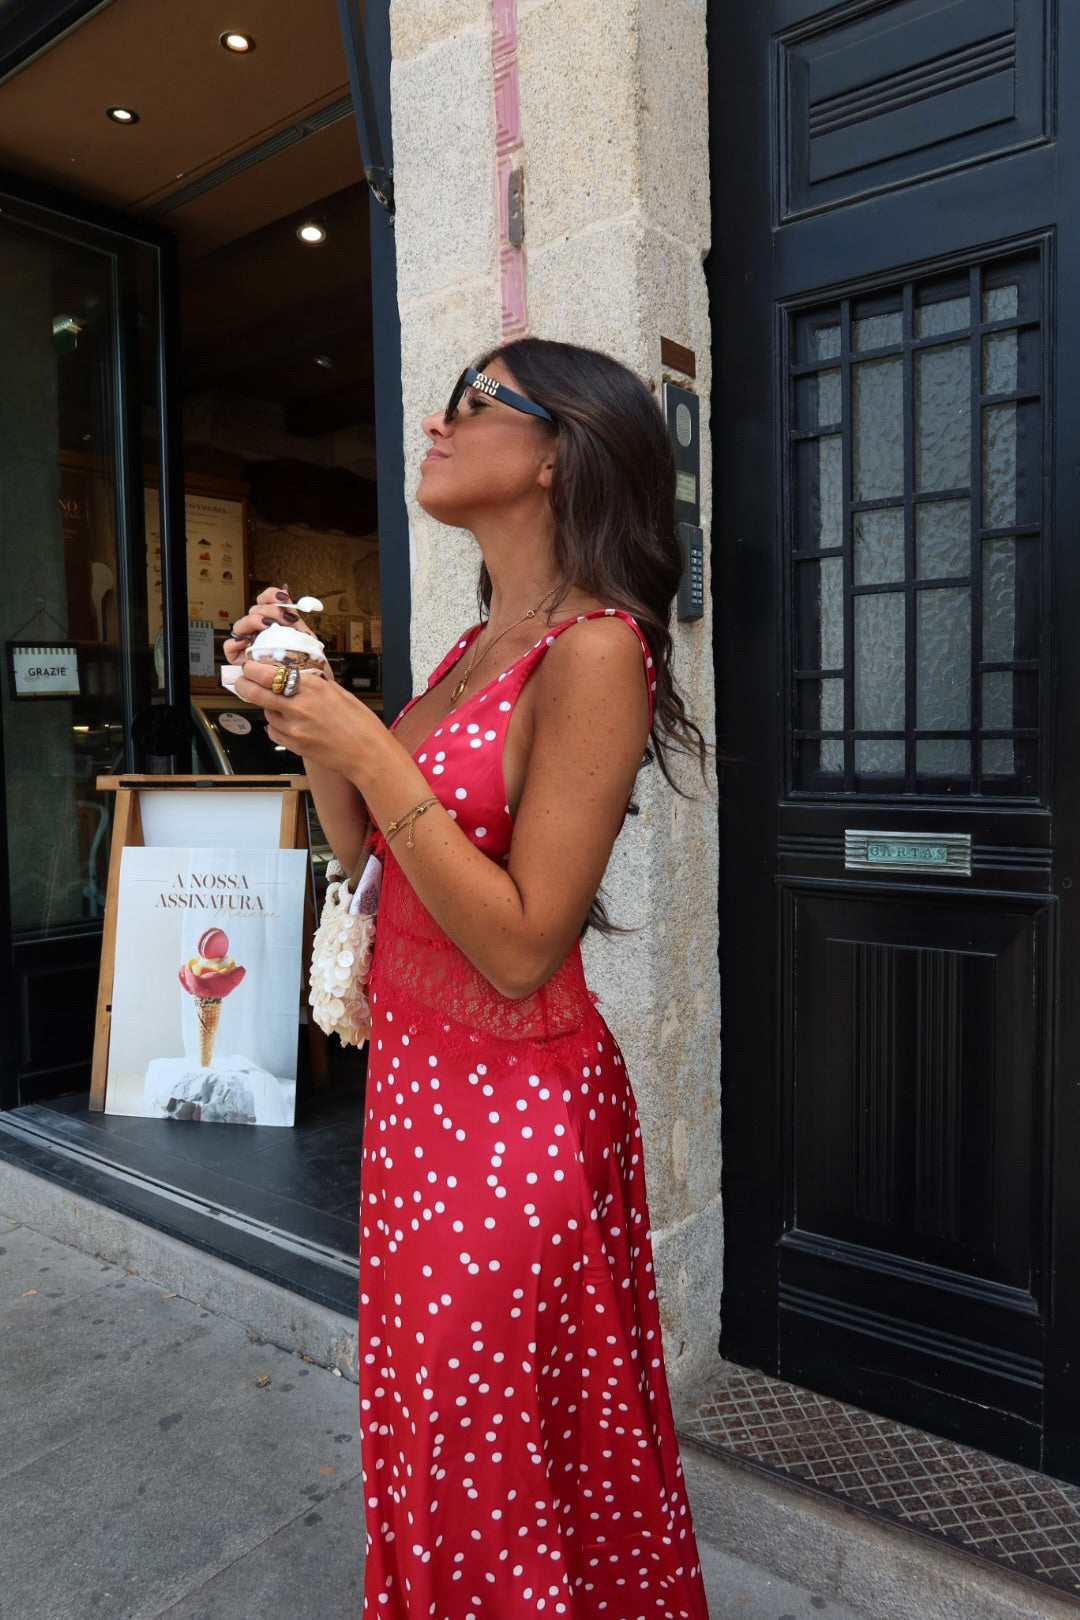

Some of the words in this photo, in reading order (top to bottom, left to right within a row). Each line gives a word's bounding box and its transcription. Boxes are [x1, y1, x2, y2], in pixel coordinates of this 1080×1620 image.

[473, 380, 497, 396] miu
[476, 373, 500, 389] miu
[28, 667, 67, 677] GRAZIE
[869, 844, 945, 860] CARTAS
[172, 873, 184, 888] A
[190, 873, 249, 889] NOSSA
[154, 893, 264, 910] ASSINATURA
